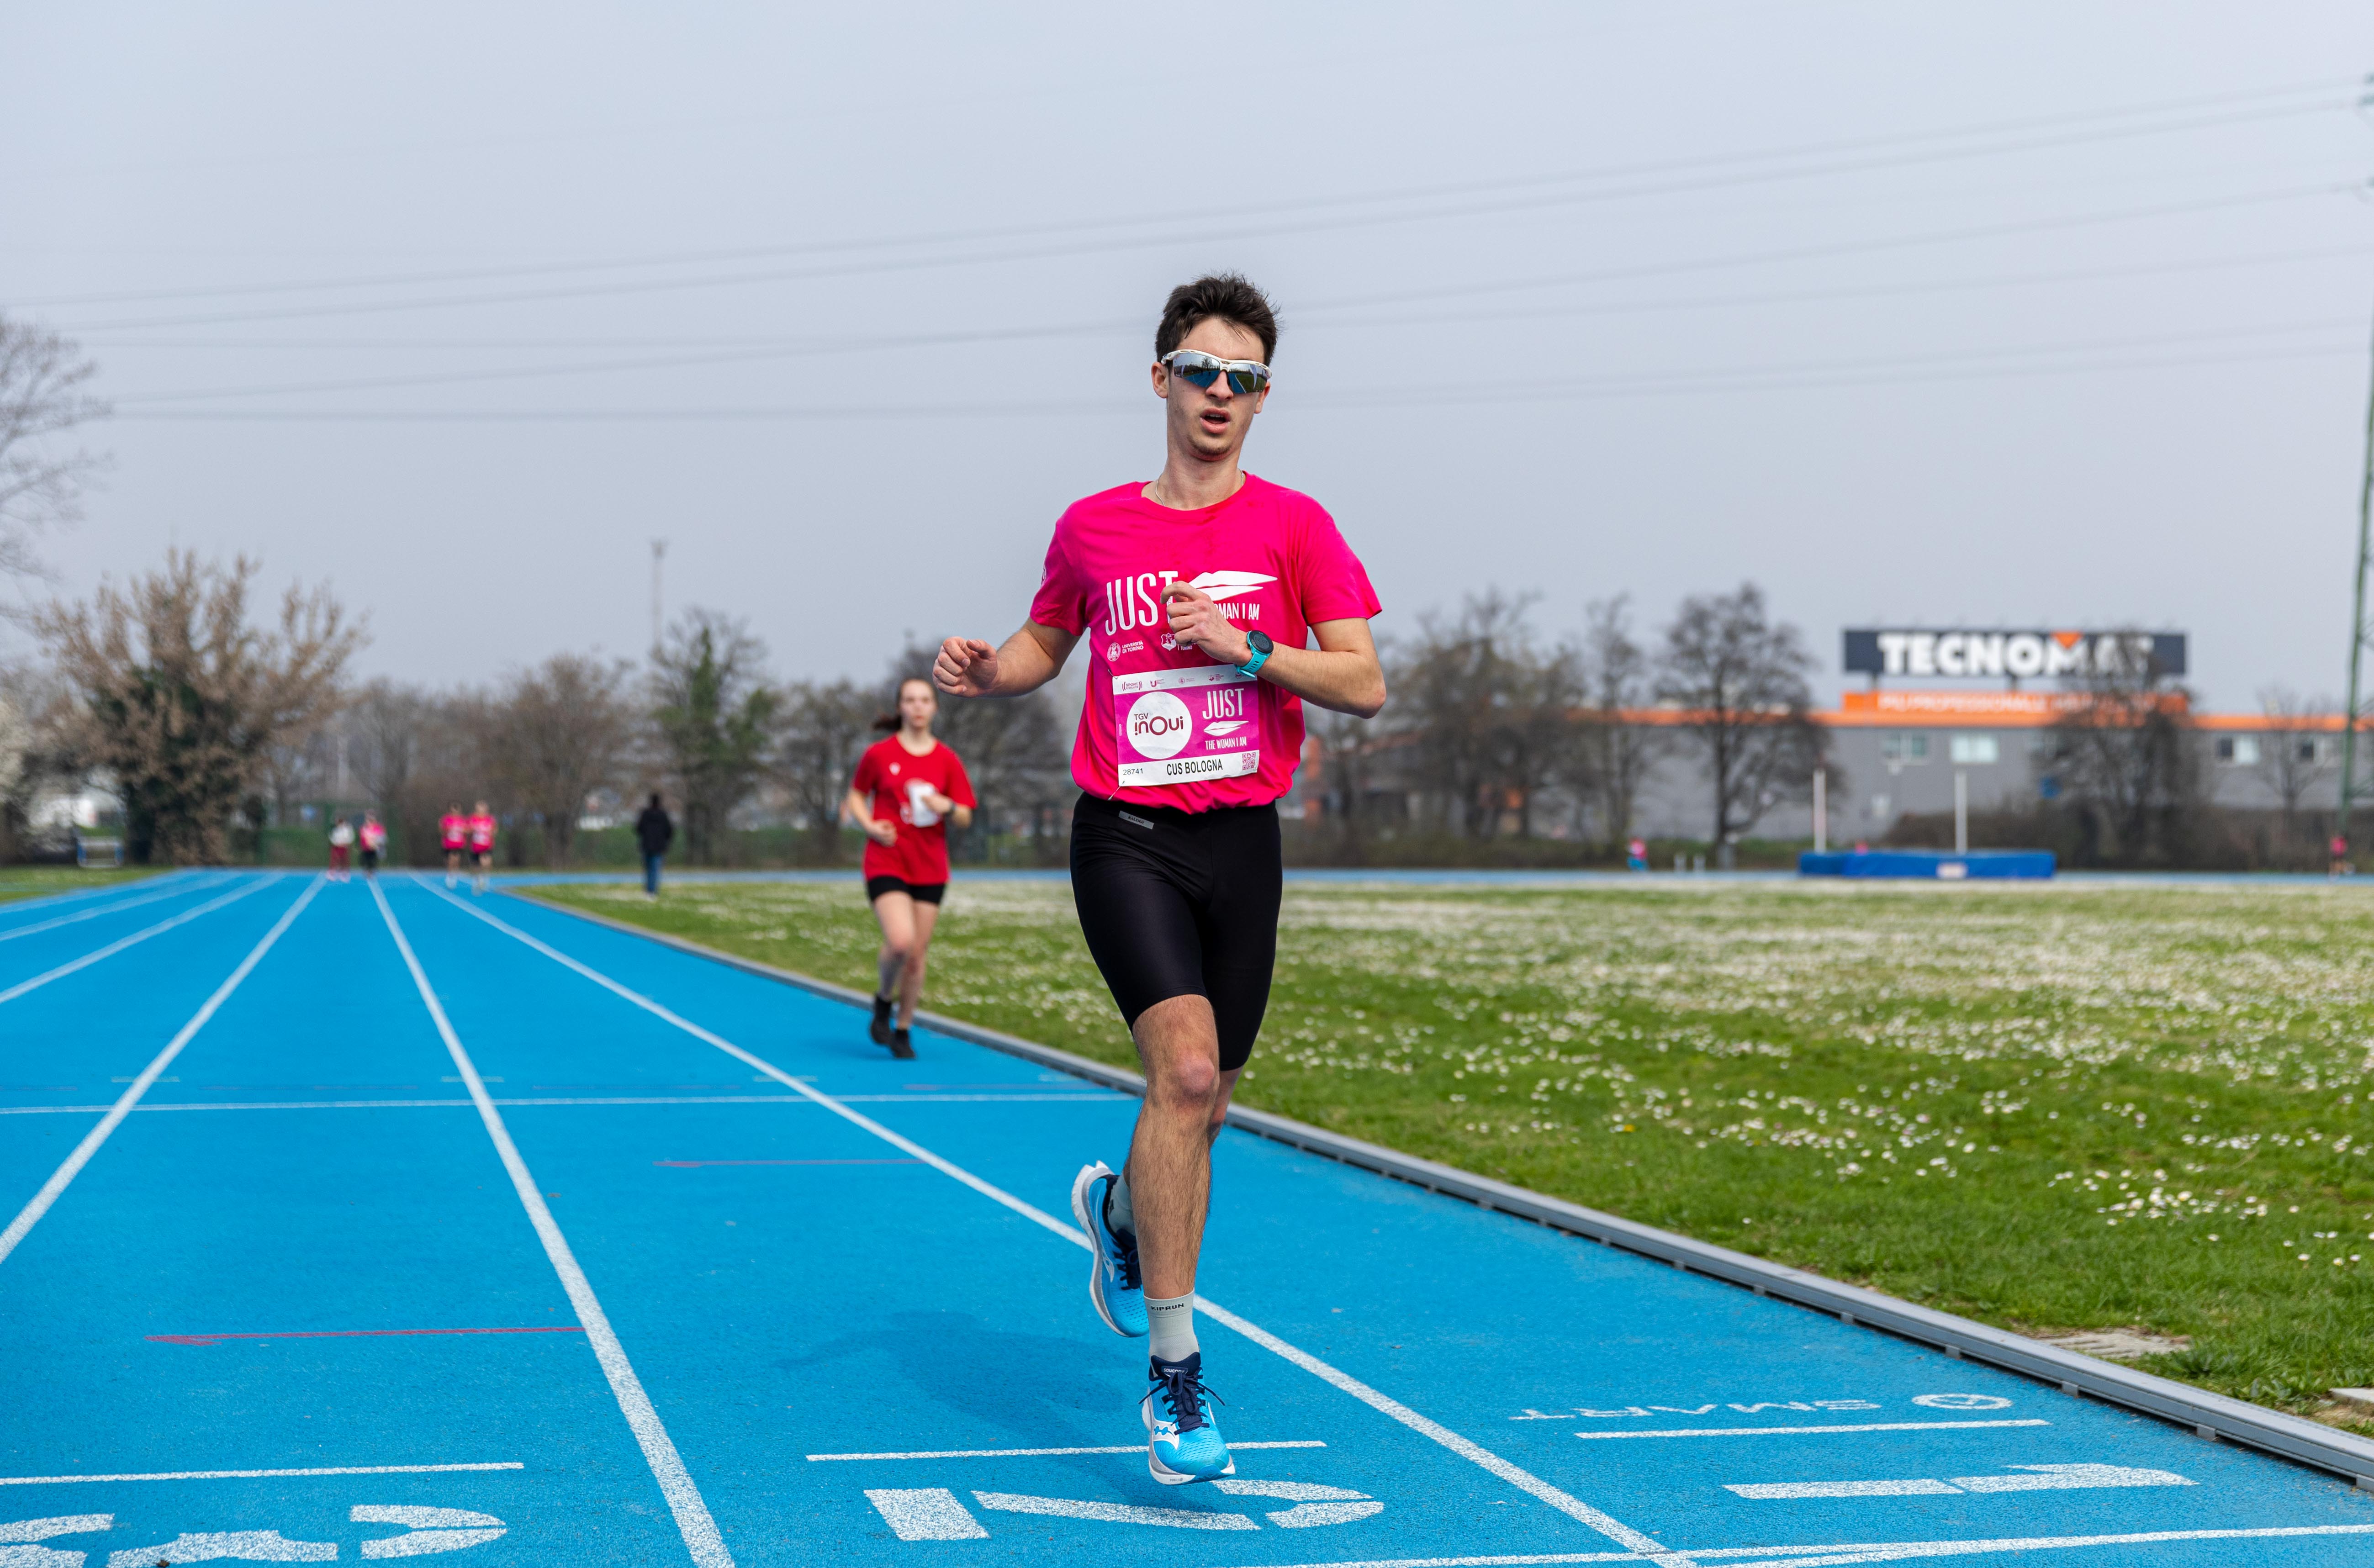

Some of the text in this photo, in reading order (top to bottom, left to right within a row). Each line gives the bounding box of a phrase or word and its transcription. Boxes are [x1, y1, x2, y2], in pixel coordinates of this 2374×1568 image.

[1105, 571, 1179, 636] JUST
[1242, 602, 1246, 619] I
[1248, 603, 1260, 621] AM
[1878, 631, 2154, 677] TECNOMAT
[1202, 688, 1244, 720] JUST
[1205, 736, 1247, 750] THE WOMAN I AM
[1166, 759, 1223, 776] CUS BOLOGNA
[1127, 816, 1145, 824] KALENJI
[1151, 1303, 1184, 1311] KIPRUN
[1508, 1399, 1882, 1421] SMART
